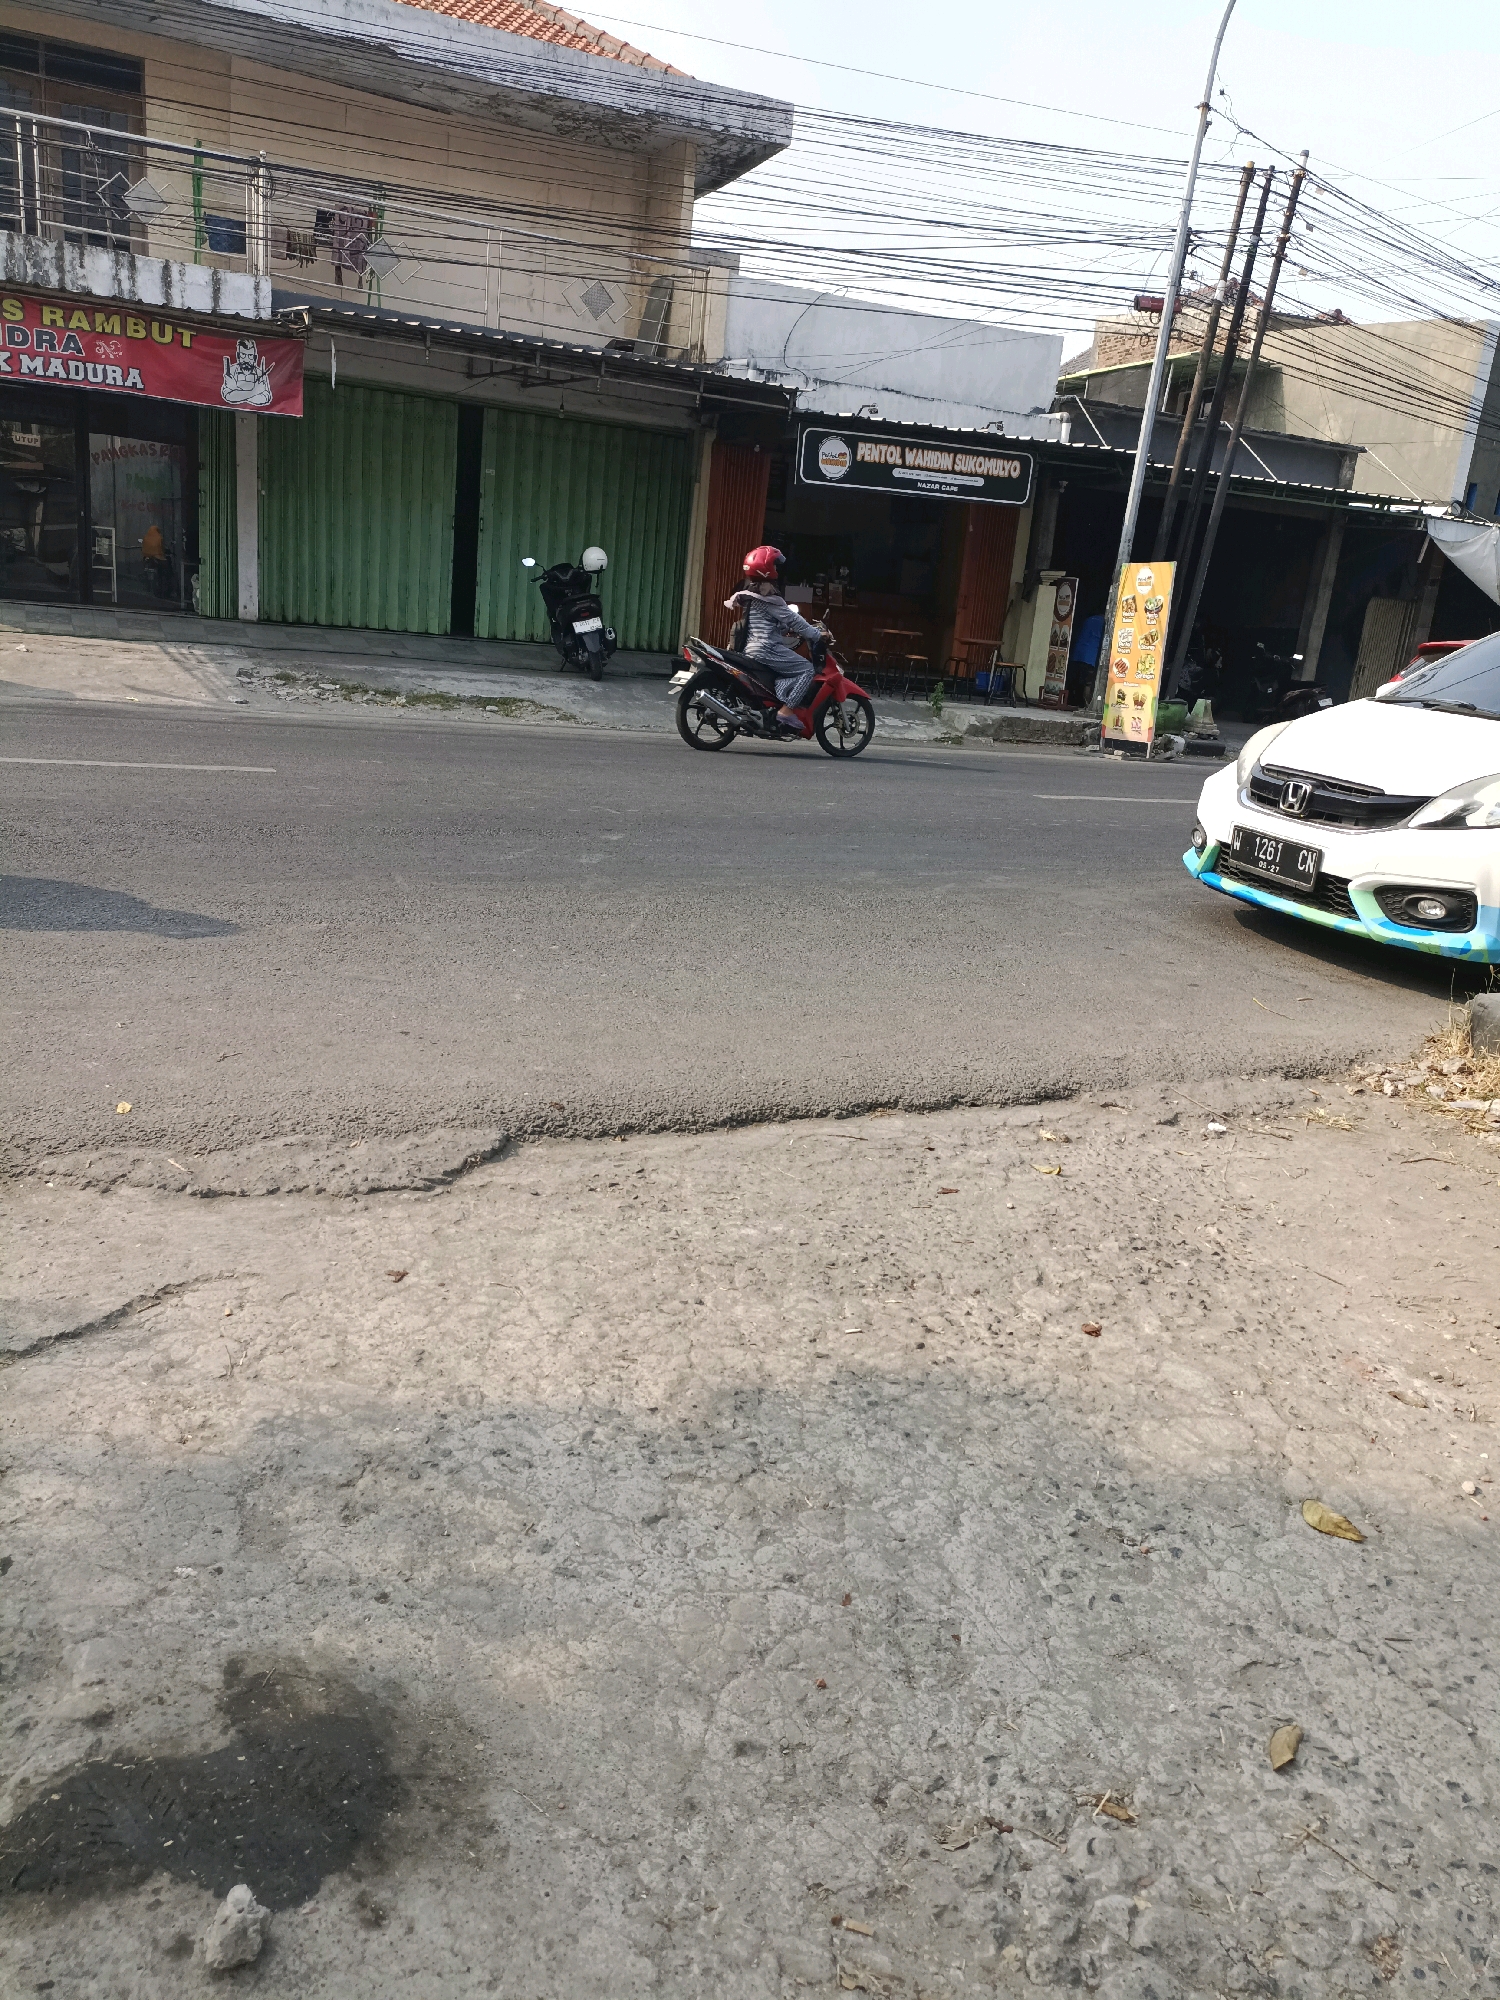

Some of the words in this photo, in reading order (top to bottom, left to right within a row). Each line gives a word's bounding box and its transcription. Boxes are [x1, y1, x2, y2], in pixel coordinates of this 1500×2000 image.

[0, 323, 85, 356] DRA
[42, 304, 197, 348] RAMBUT
[20, 354, 144, 389] MADURA
[856, 441, 902, 465] PENTOL
[905, 447, 954, 471] WAHIDIN
[955, 454, 1021, 479] SUKOMULYO
[917, 482, 940, 490] NAZAR
[1233, 829, 1242, 851] W
[1254, 836, 1283, 862] 1261
[1297, 849, 1317, 873] CN
